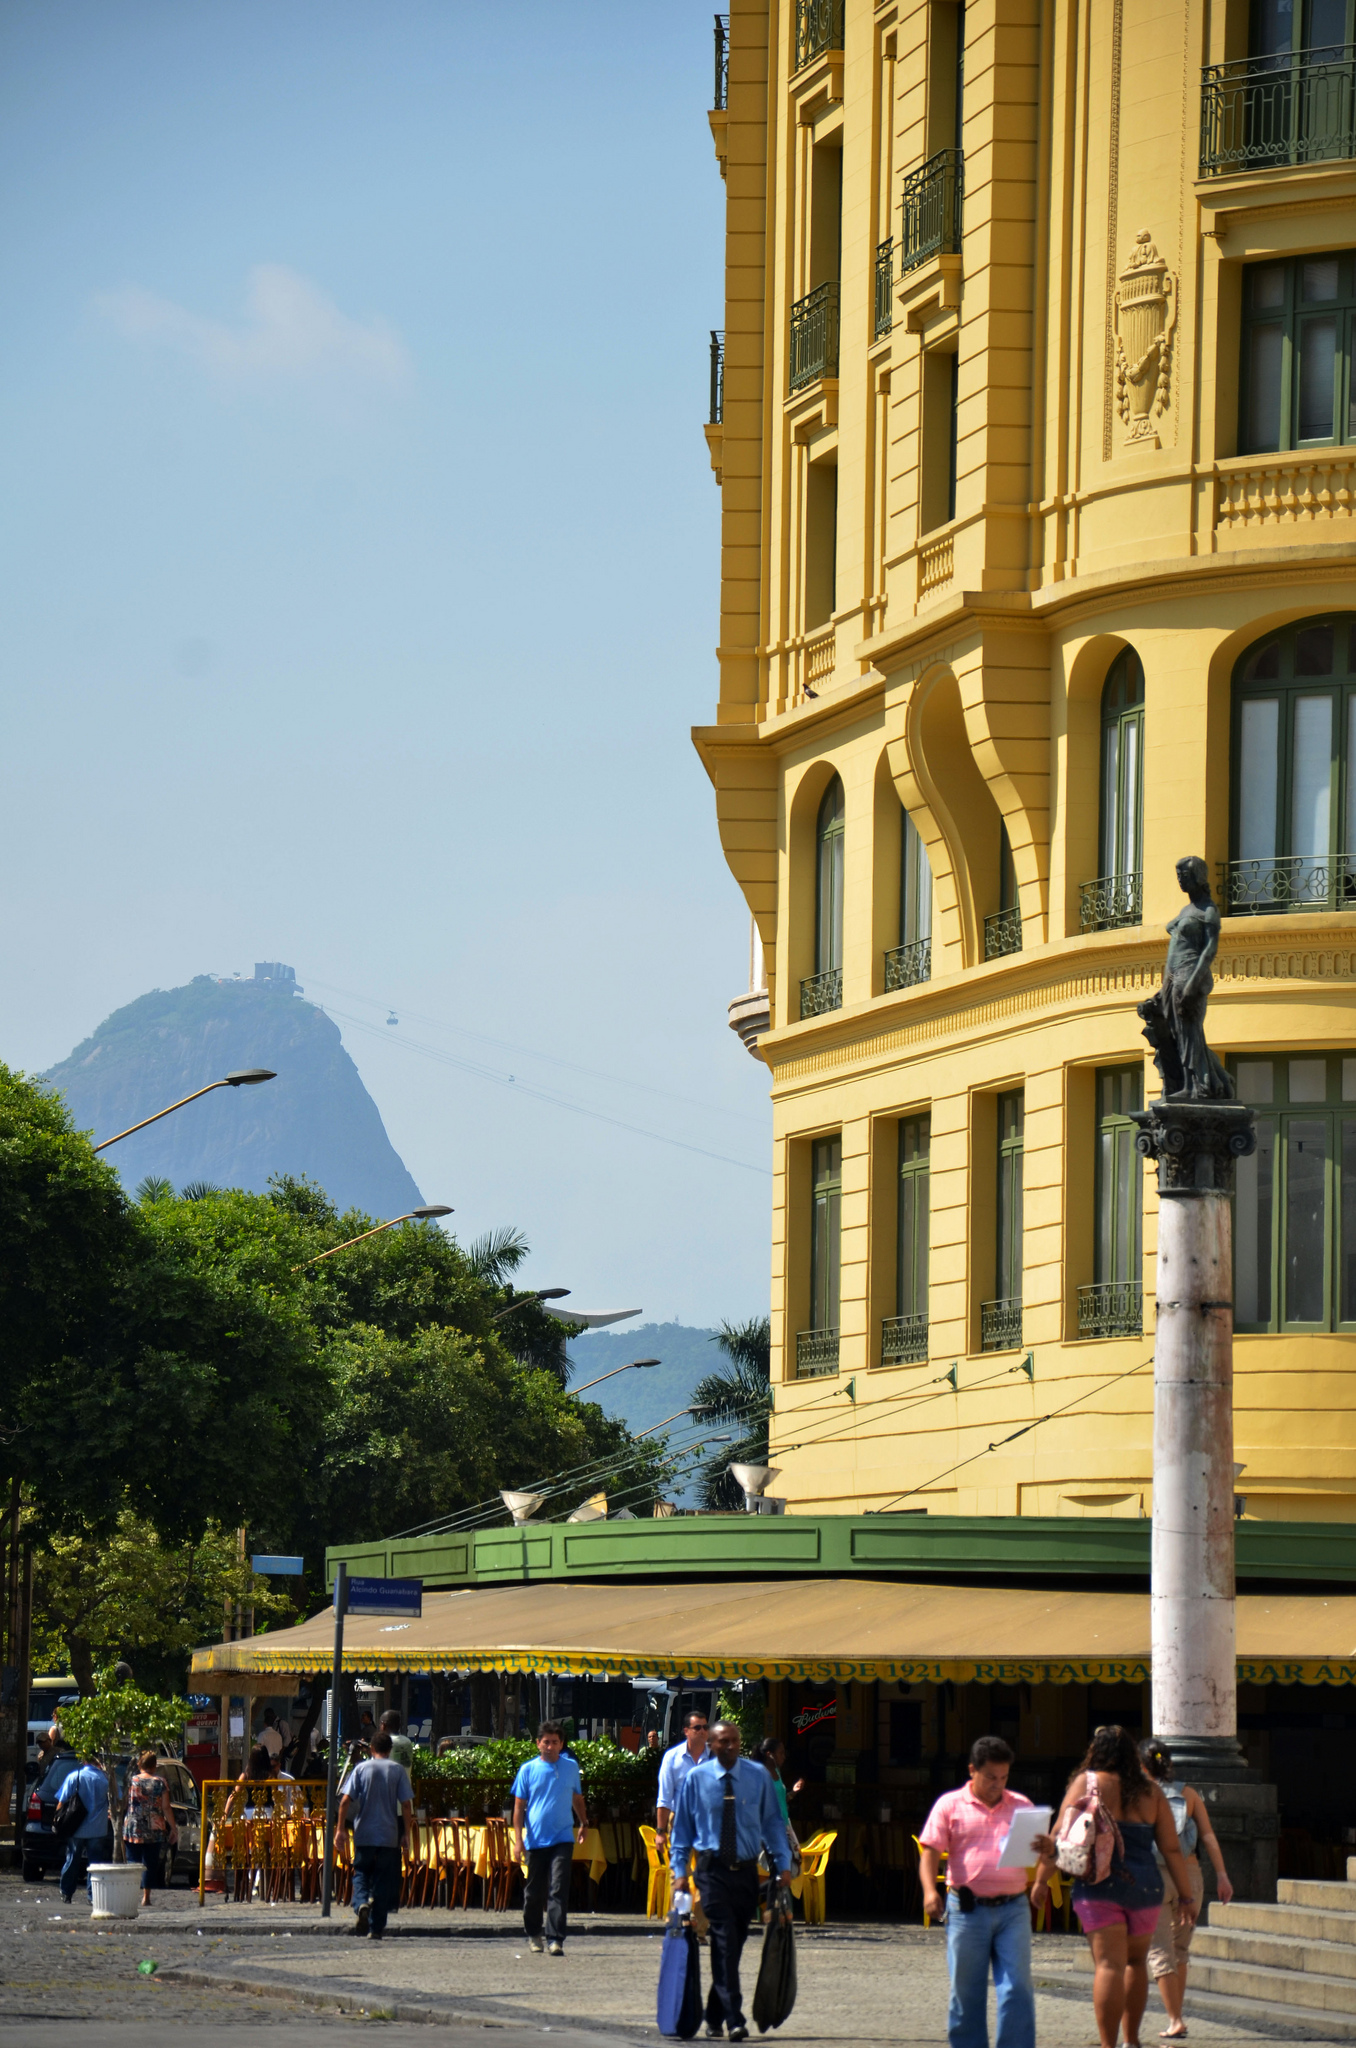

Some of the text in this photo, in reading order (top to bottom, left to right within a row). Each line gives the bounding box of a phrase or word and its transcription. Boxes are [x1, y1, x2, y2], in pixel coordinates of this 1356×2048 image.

[350, 1578, 365, 1586] Rua
[350, 1586, 418, 1596] Alcindo Guanabara
[395, 1653, 521, 1667] RESTAURANTE
[526, 1654, 571, 1669] BAR
[579, 1656, 764, 1675] AMARELINHO
[774, 1662, 878, 1677] DESDE
[888, 1663, 943, 1678] 1921
[973, 1663, 1152, 1679] RESTAURA
[1236, 1664, 1304, 1679] BAR
[1312, 1664, 1356, 1680] AM
